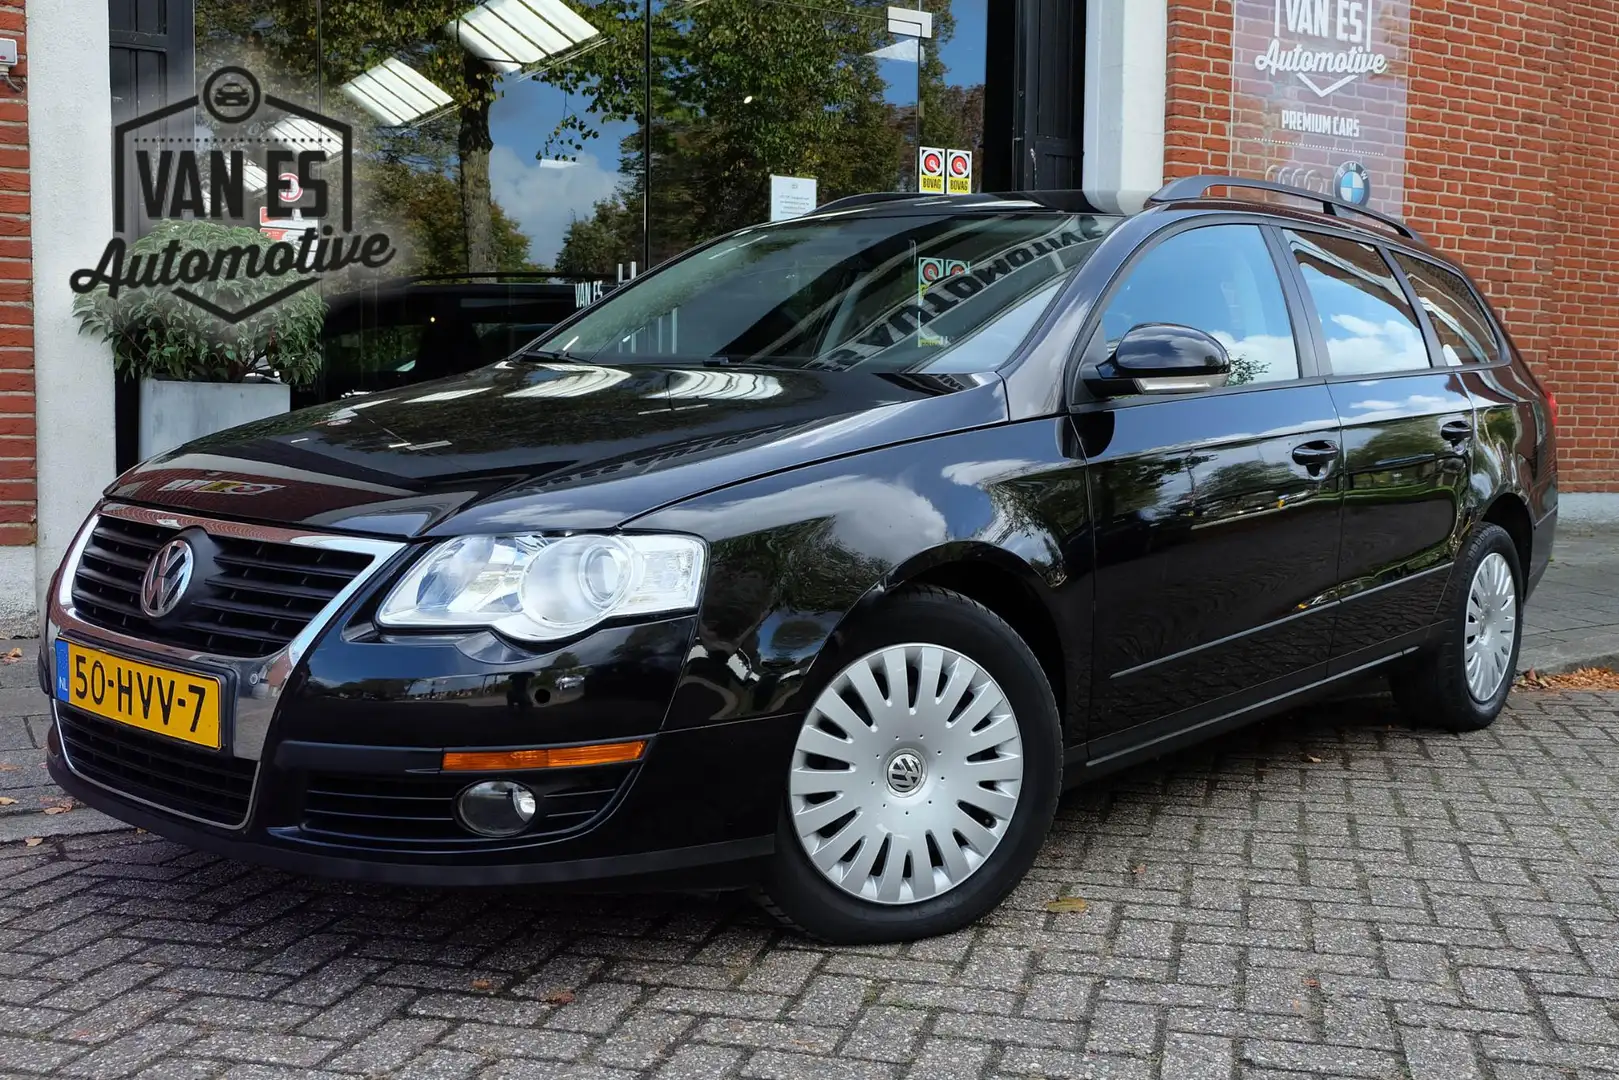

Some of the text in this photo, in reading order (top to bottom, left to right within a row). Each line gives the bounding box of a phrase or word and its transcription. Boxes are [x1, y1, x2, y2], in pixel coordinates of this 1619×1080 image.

[1285, 0, 1363, 43] VAN ES
[1254, 38, 1388, 76] Automotive
[1281, 109, 1360, 138] PREMIUM CARS
[922, 177, 942, 190] BOVAG
[950, 179, 969, 192] BOVAG
[575, 281, 591, 308] VAN
[59, 676, 68, 691] NL
[75, 653, 206, 733] 50-HVV-7
